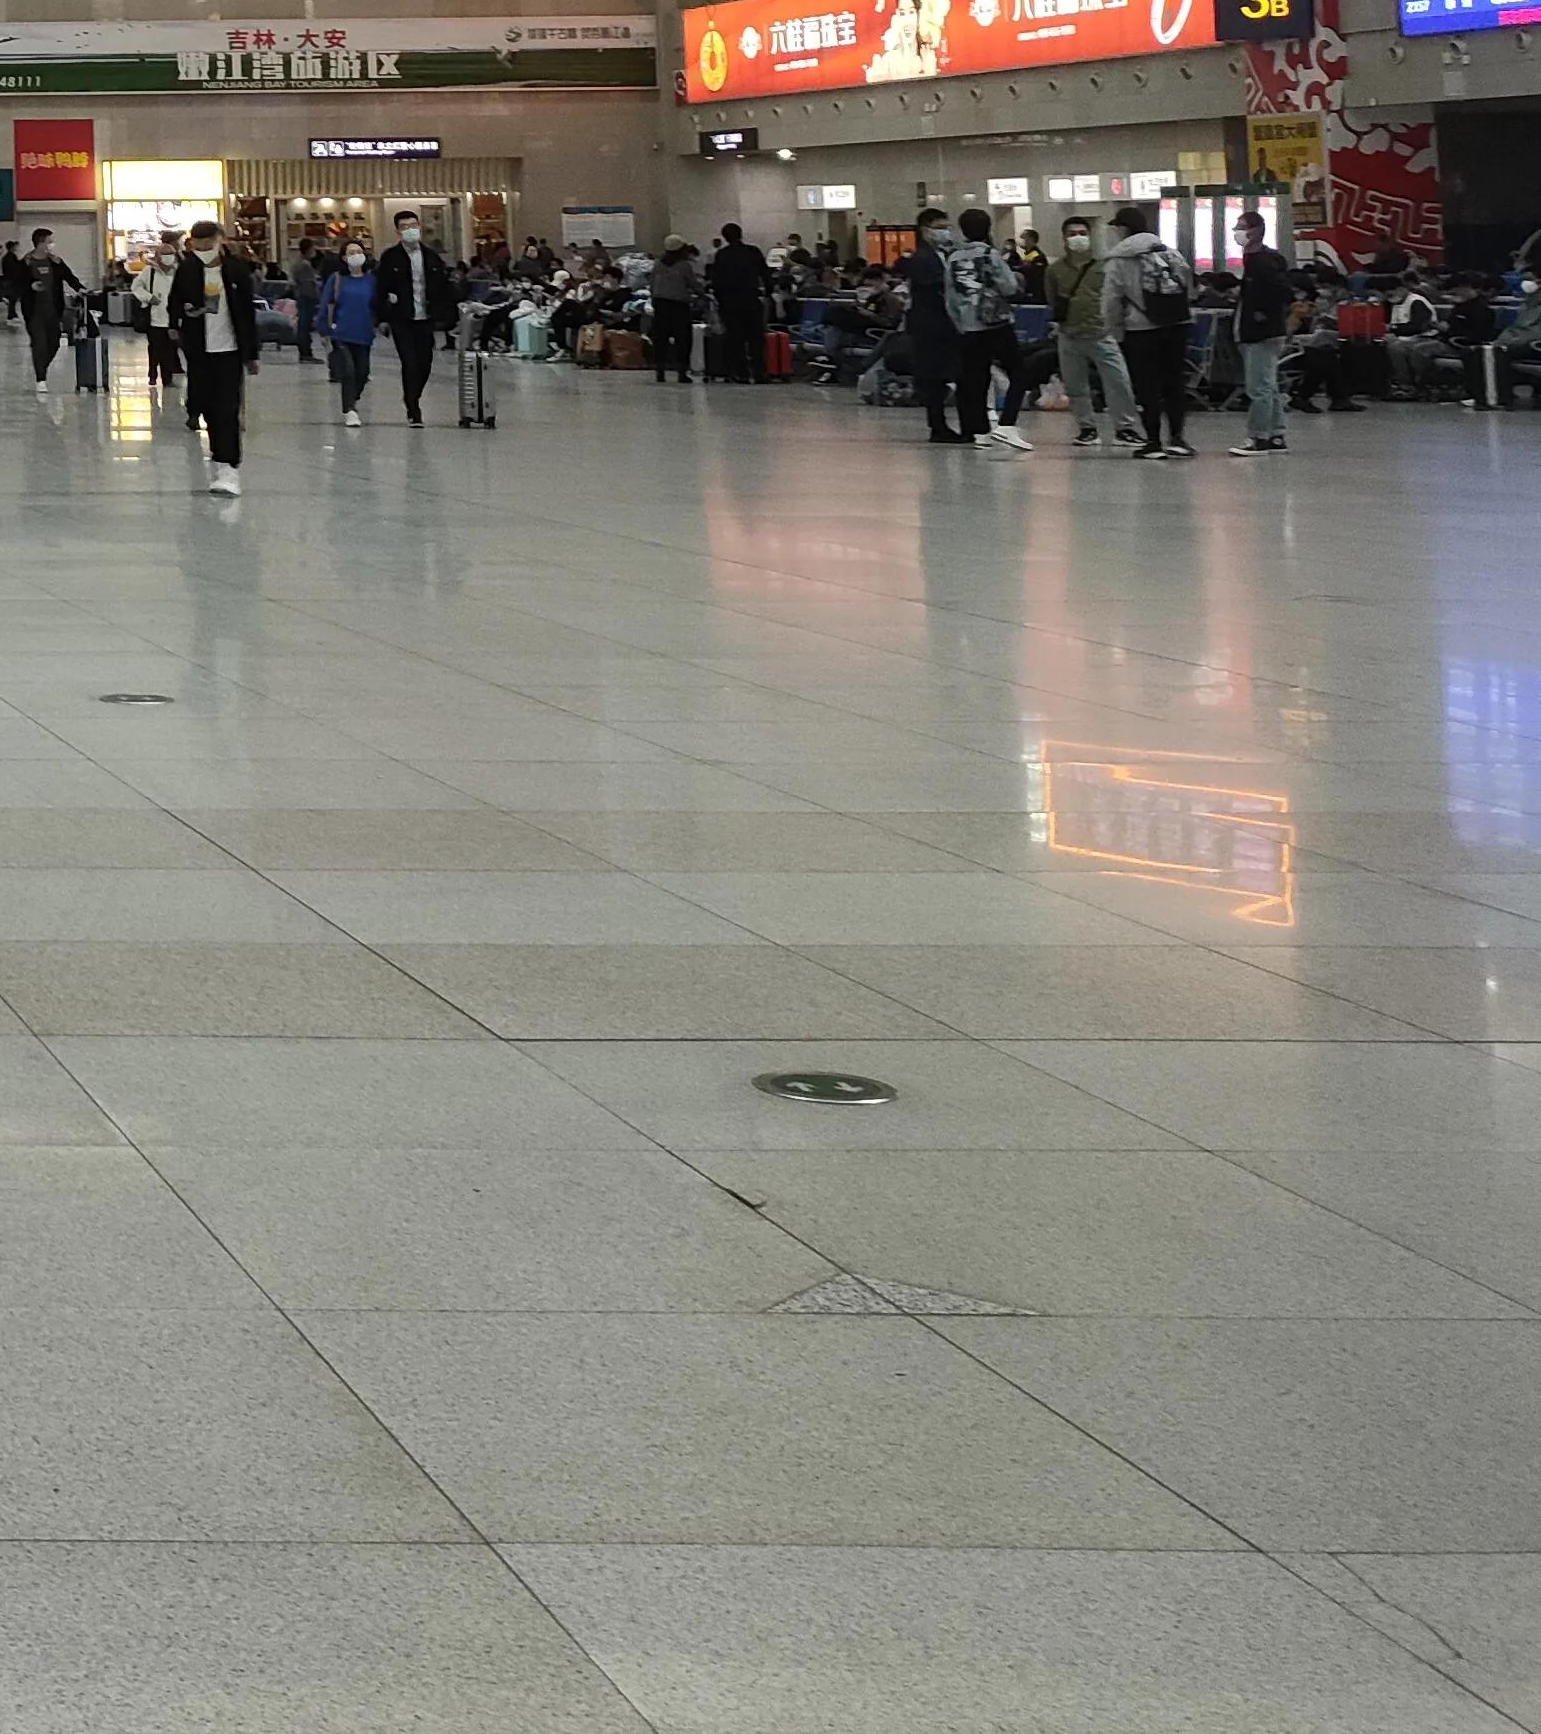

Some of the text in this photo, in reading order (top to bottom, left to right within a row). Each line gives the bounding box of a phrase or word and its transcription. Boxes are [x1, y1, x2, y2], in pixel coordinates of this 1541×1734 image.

[226, 28, 347, 51] 吉林·大安
[768, 10, 857, 55] 六桂福珠宝
[176, 50, 402, 81] 嫩江湾旅游区
[202, 79, 380, 89] NENJIANG BAY TOURISM AREA
